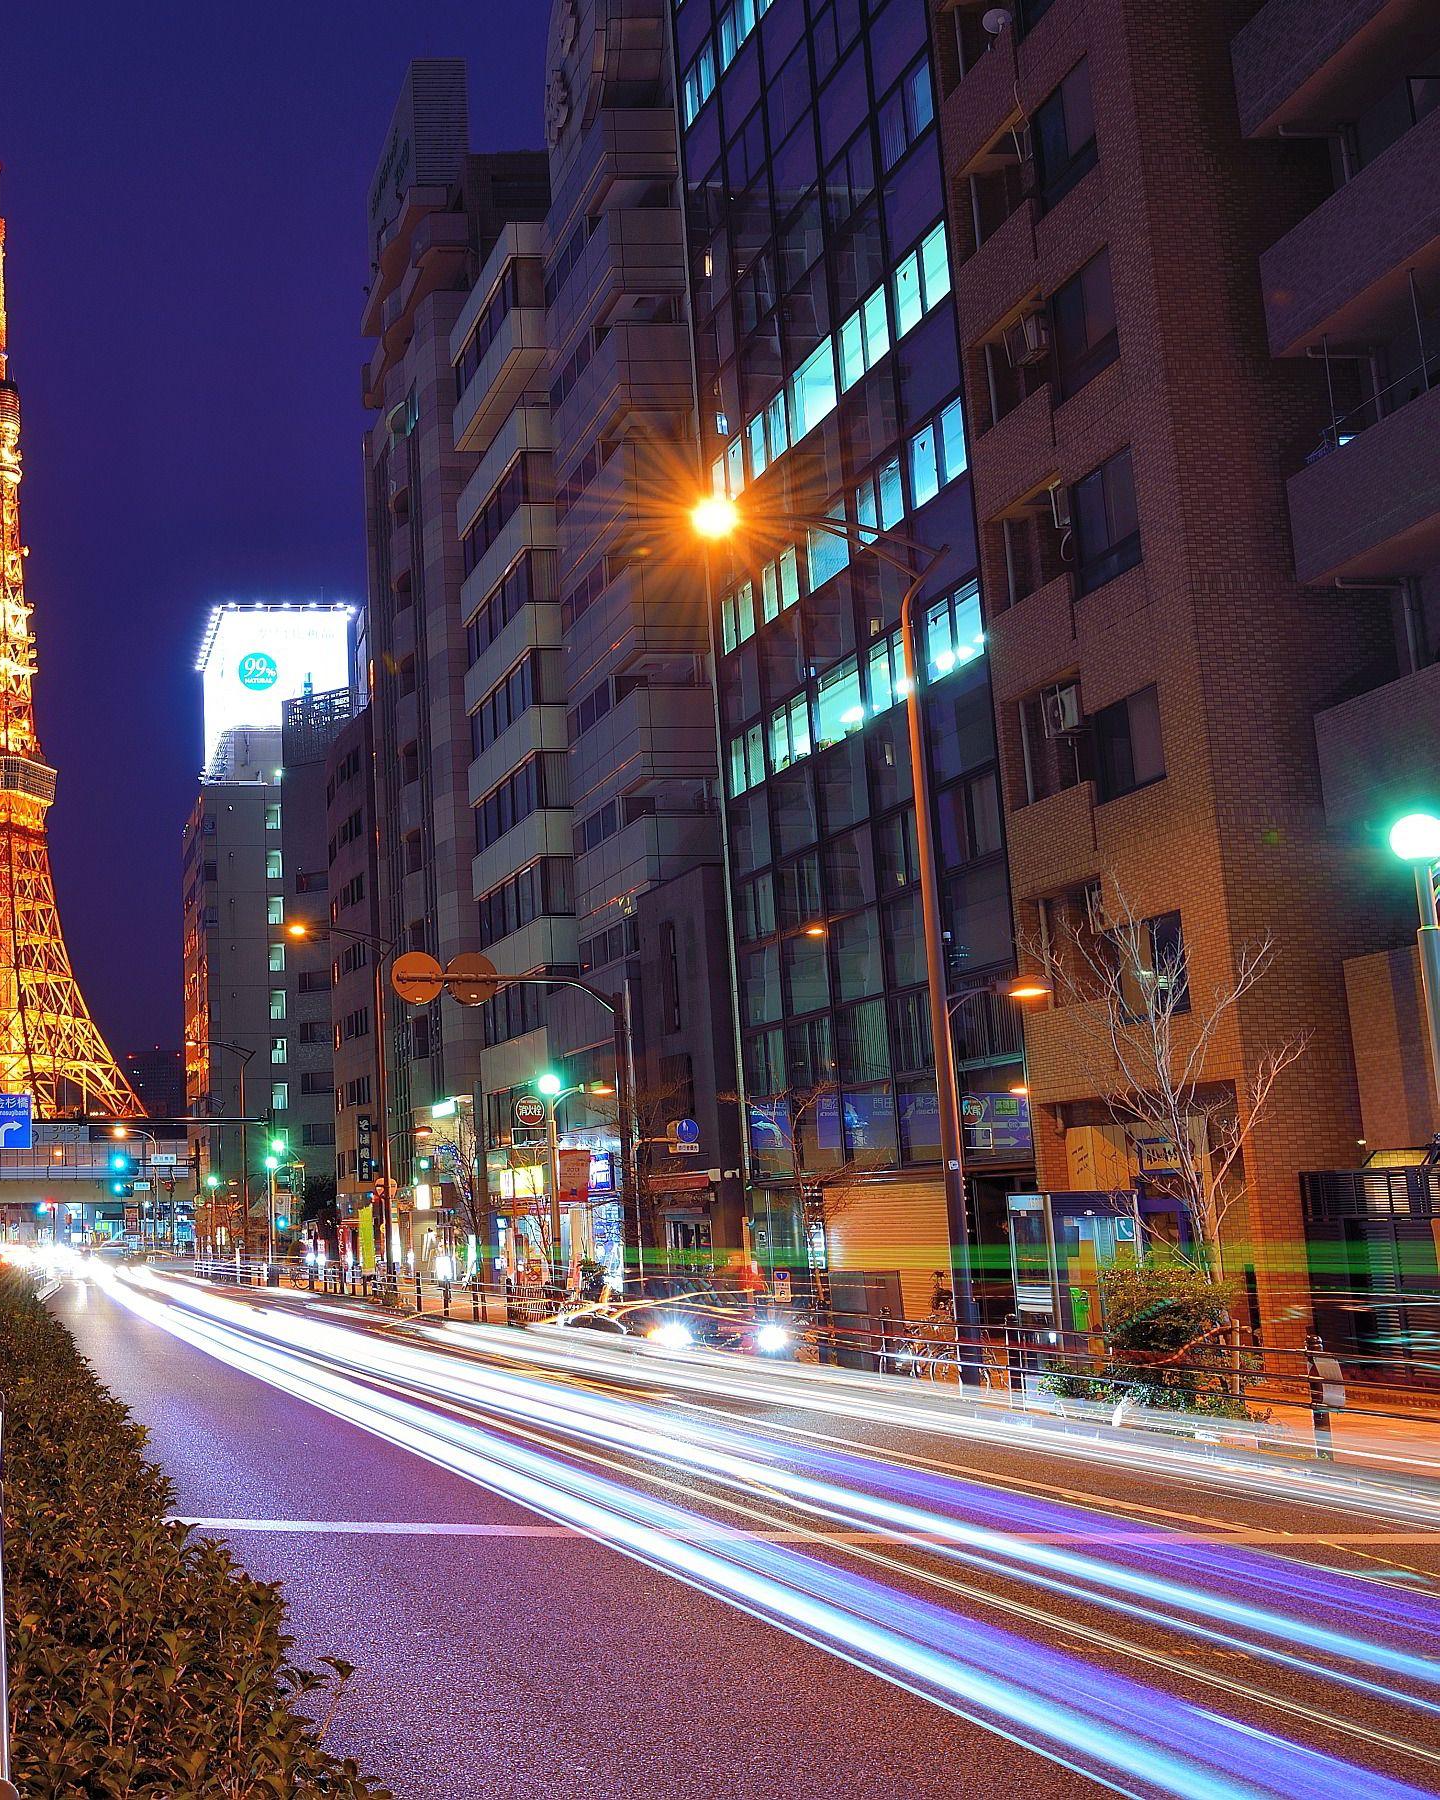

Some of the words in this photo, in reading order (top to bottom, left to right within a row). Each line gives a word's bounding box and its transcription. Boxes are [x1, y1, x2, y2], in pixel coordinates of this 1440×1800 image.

[244, 657, 276, 678] 99%
[519, 1104, 542, 1116] 消火栓
